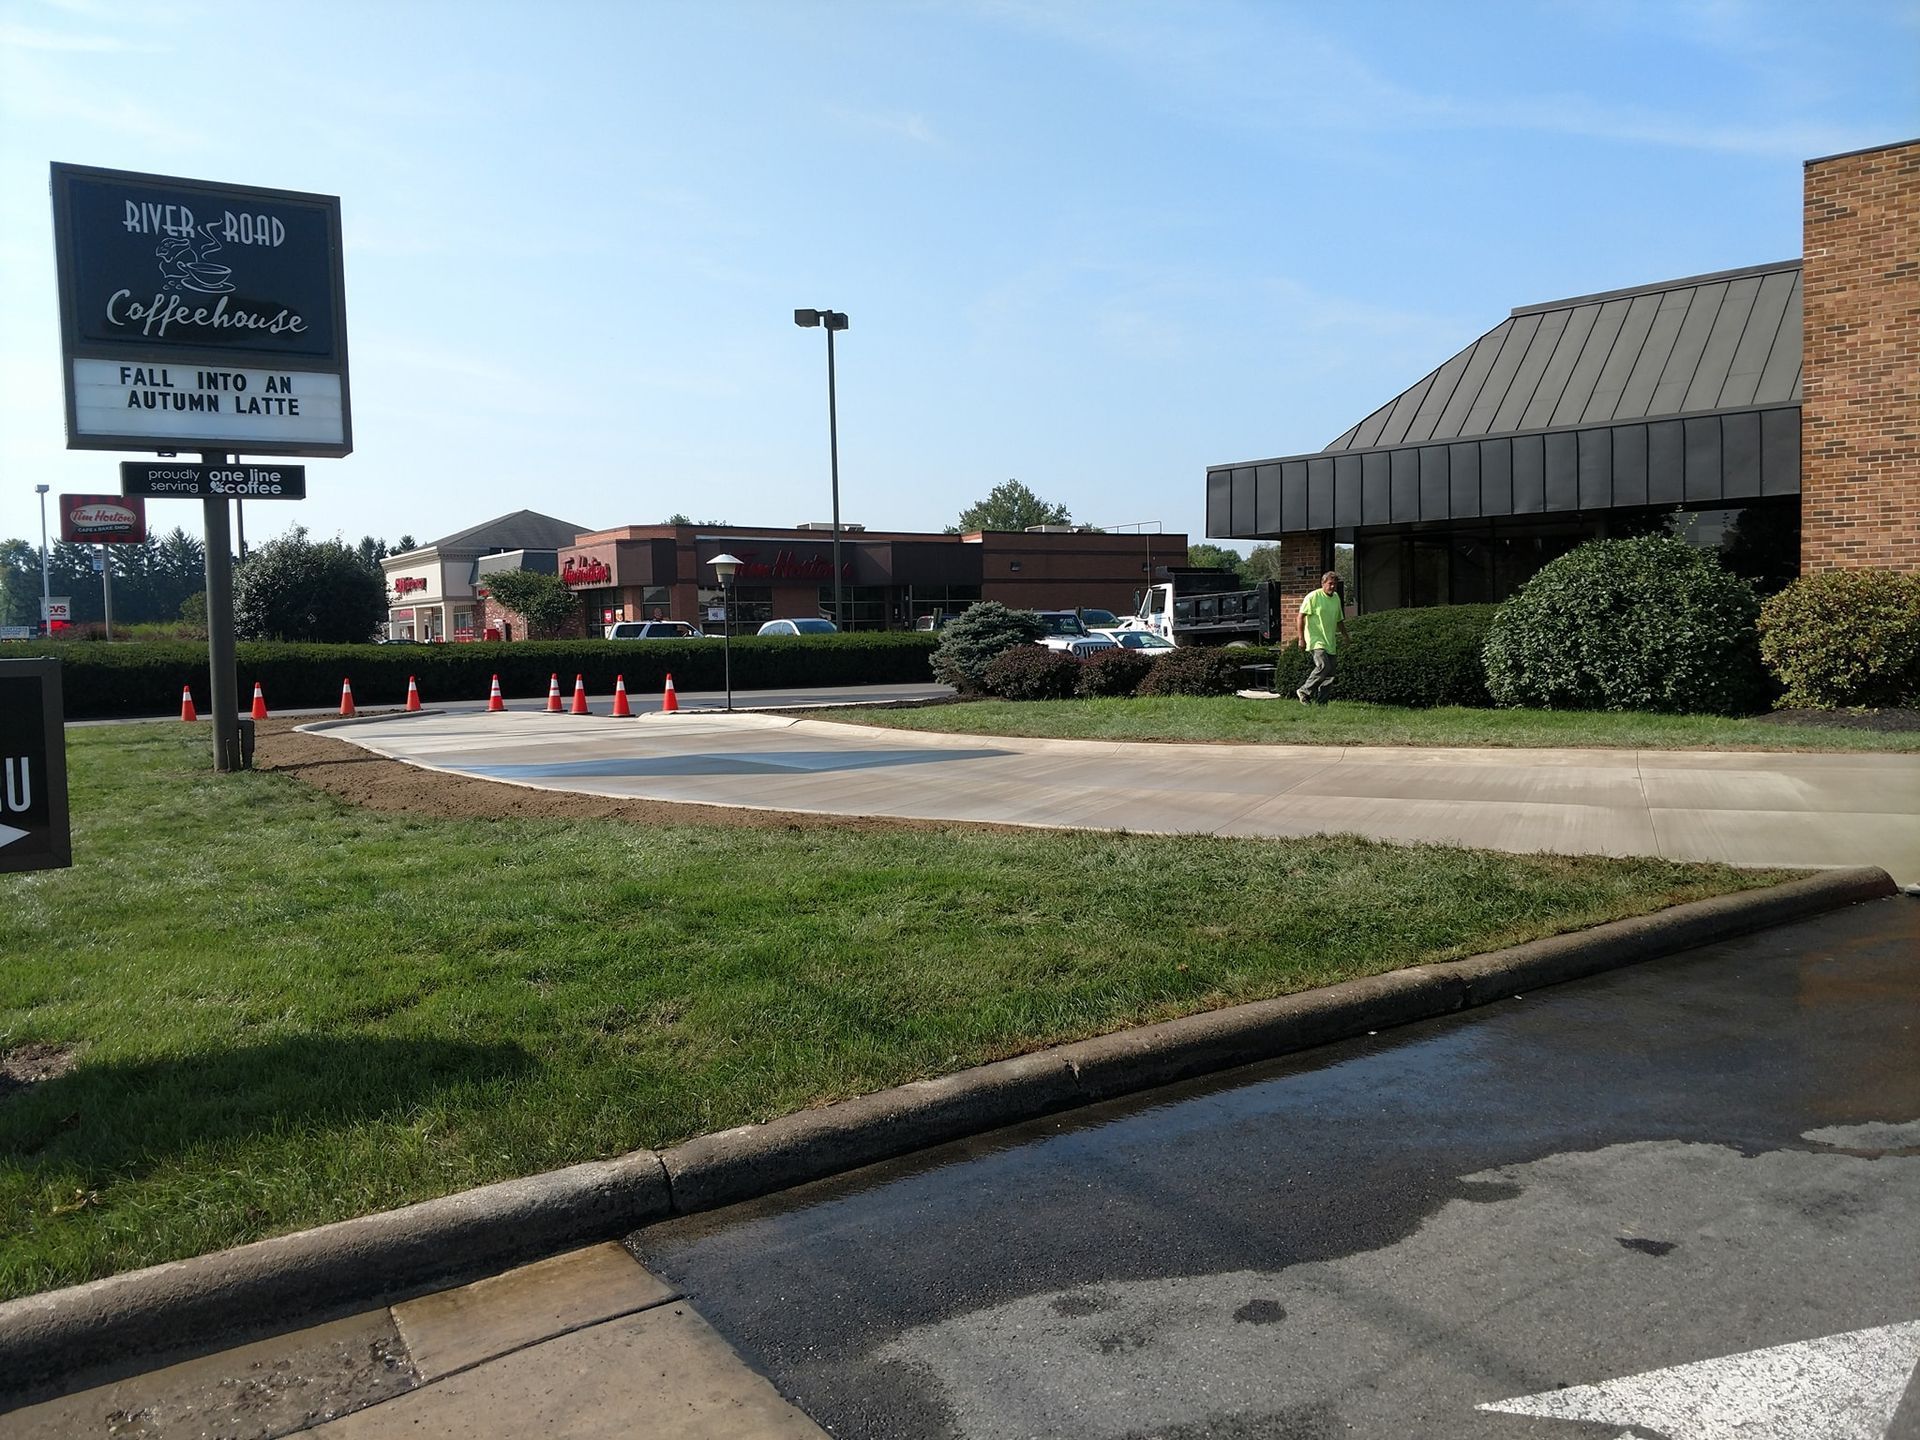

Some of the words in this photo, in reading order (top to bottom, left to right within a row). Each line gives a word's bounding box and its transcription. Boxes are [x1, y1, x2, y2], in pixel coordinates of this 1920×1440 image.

[123, 200, 196, 238] RIVER
[222, 211, 286, 248] ROAD
[106, 289, 309, 337] Coffeehouse
[120, 367, 174, 388] FALL
[197, 371, 247, 392] INTO
[265, 375, 292, 394] AN
[127, 390, 219, 413] AUTUMN
[235, 396, 300, 416] LATTE
[148, 469, 200, 481] proudly
[209, 470, 245, 482] one
[249, 469, 281, 482] line
[150, 482, 199, 492] serving
[225, 481, 282, 494] coffee
[73, 509, 93, 521] Tim
